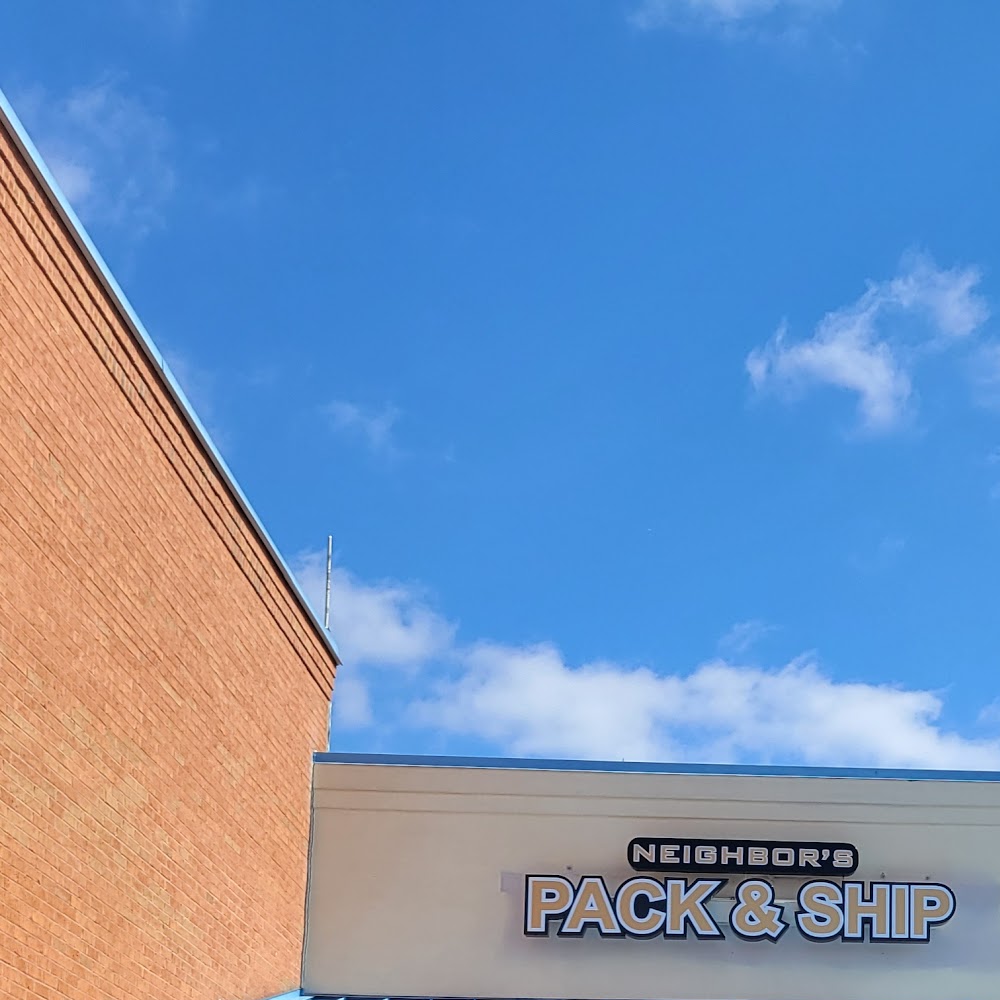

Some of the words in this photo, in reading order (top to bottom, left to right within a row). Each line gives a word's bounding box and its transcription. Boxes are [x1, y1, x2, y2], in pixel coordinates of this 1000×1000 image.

[632, 843, 854, 868] NEIGHBOR'S
[525, 874, 728, 939] PACK
[729, 877, 787, 943] &
[796, 880, 956, 943] SHIP
